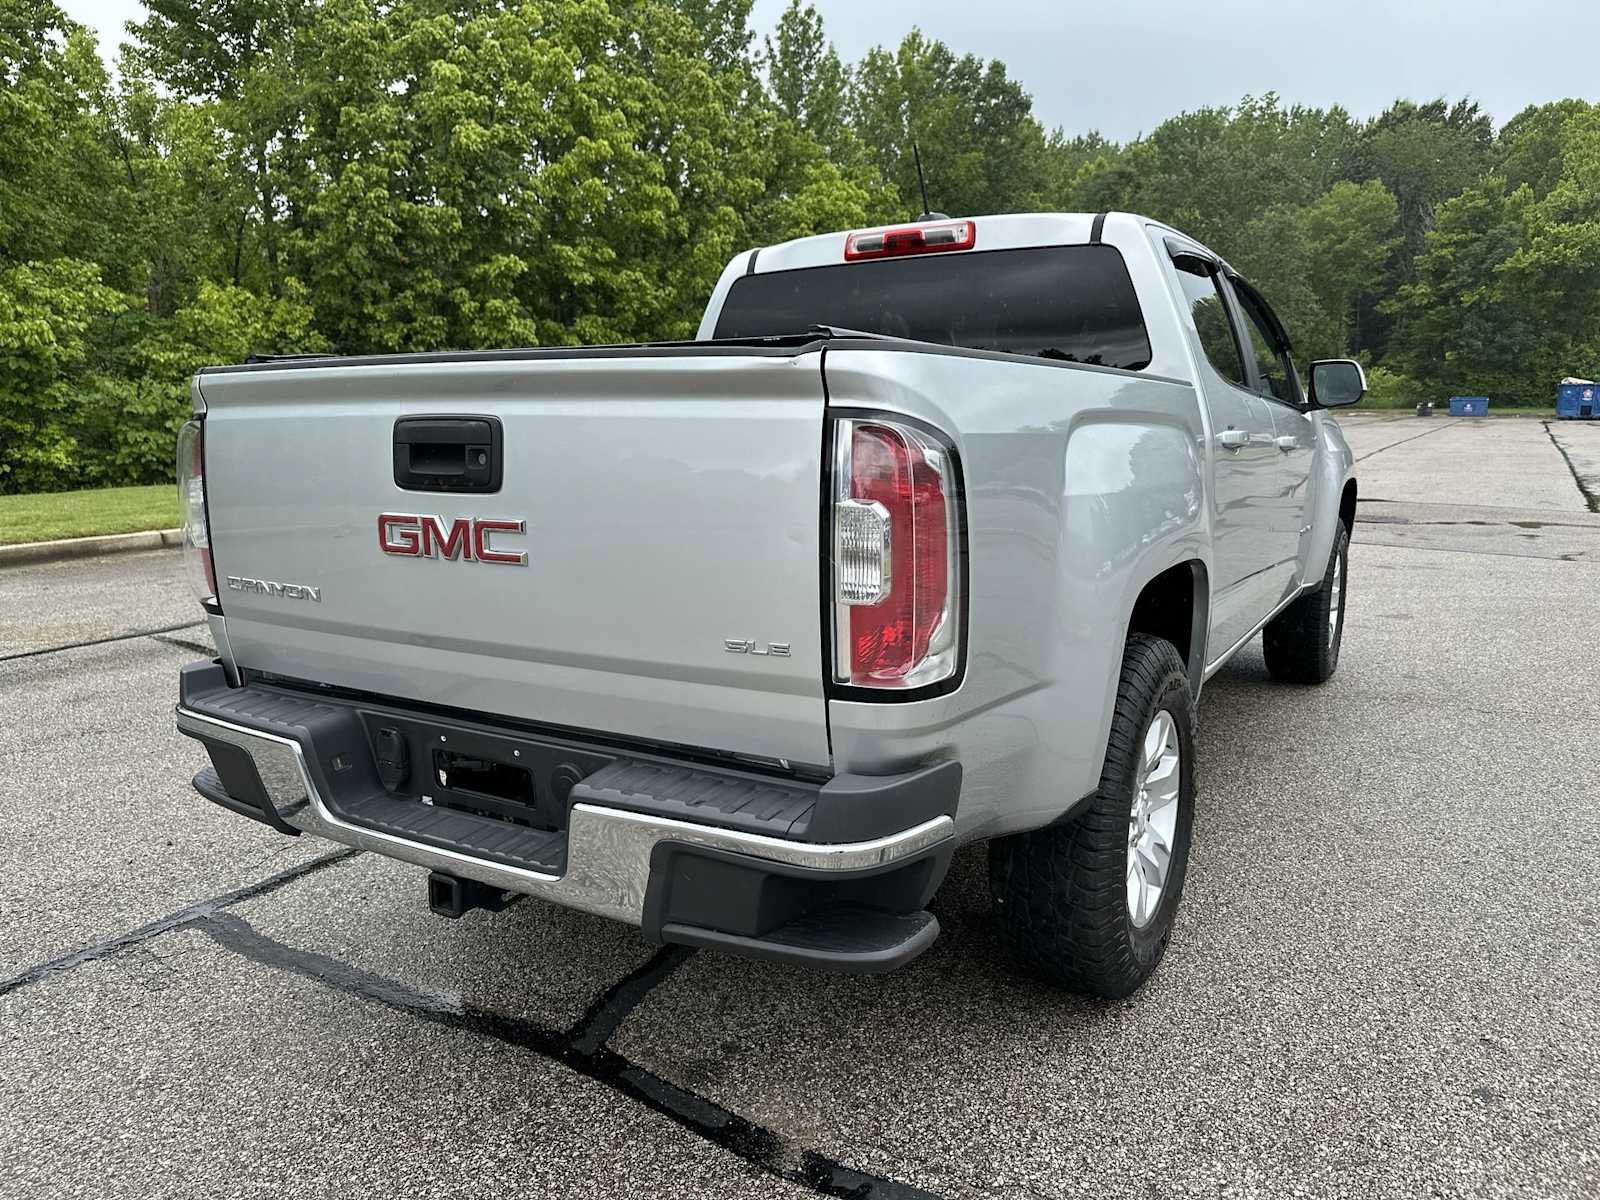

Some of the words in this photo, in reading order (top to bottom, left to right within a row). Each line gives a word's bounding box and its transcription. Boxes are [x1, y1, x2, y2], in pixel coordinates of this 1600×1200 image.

[378, 512, 528, 567] GMC
[227, 575, 321, 602] CANYON
[724, 639, 791, 657] SLE
